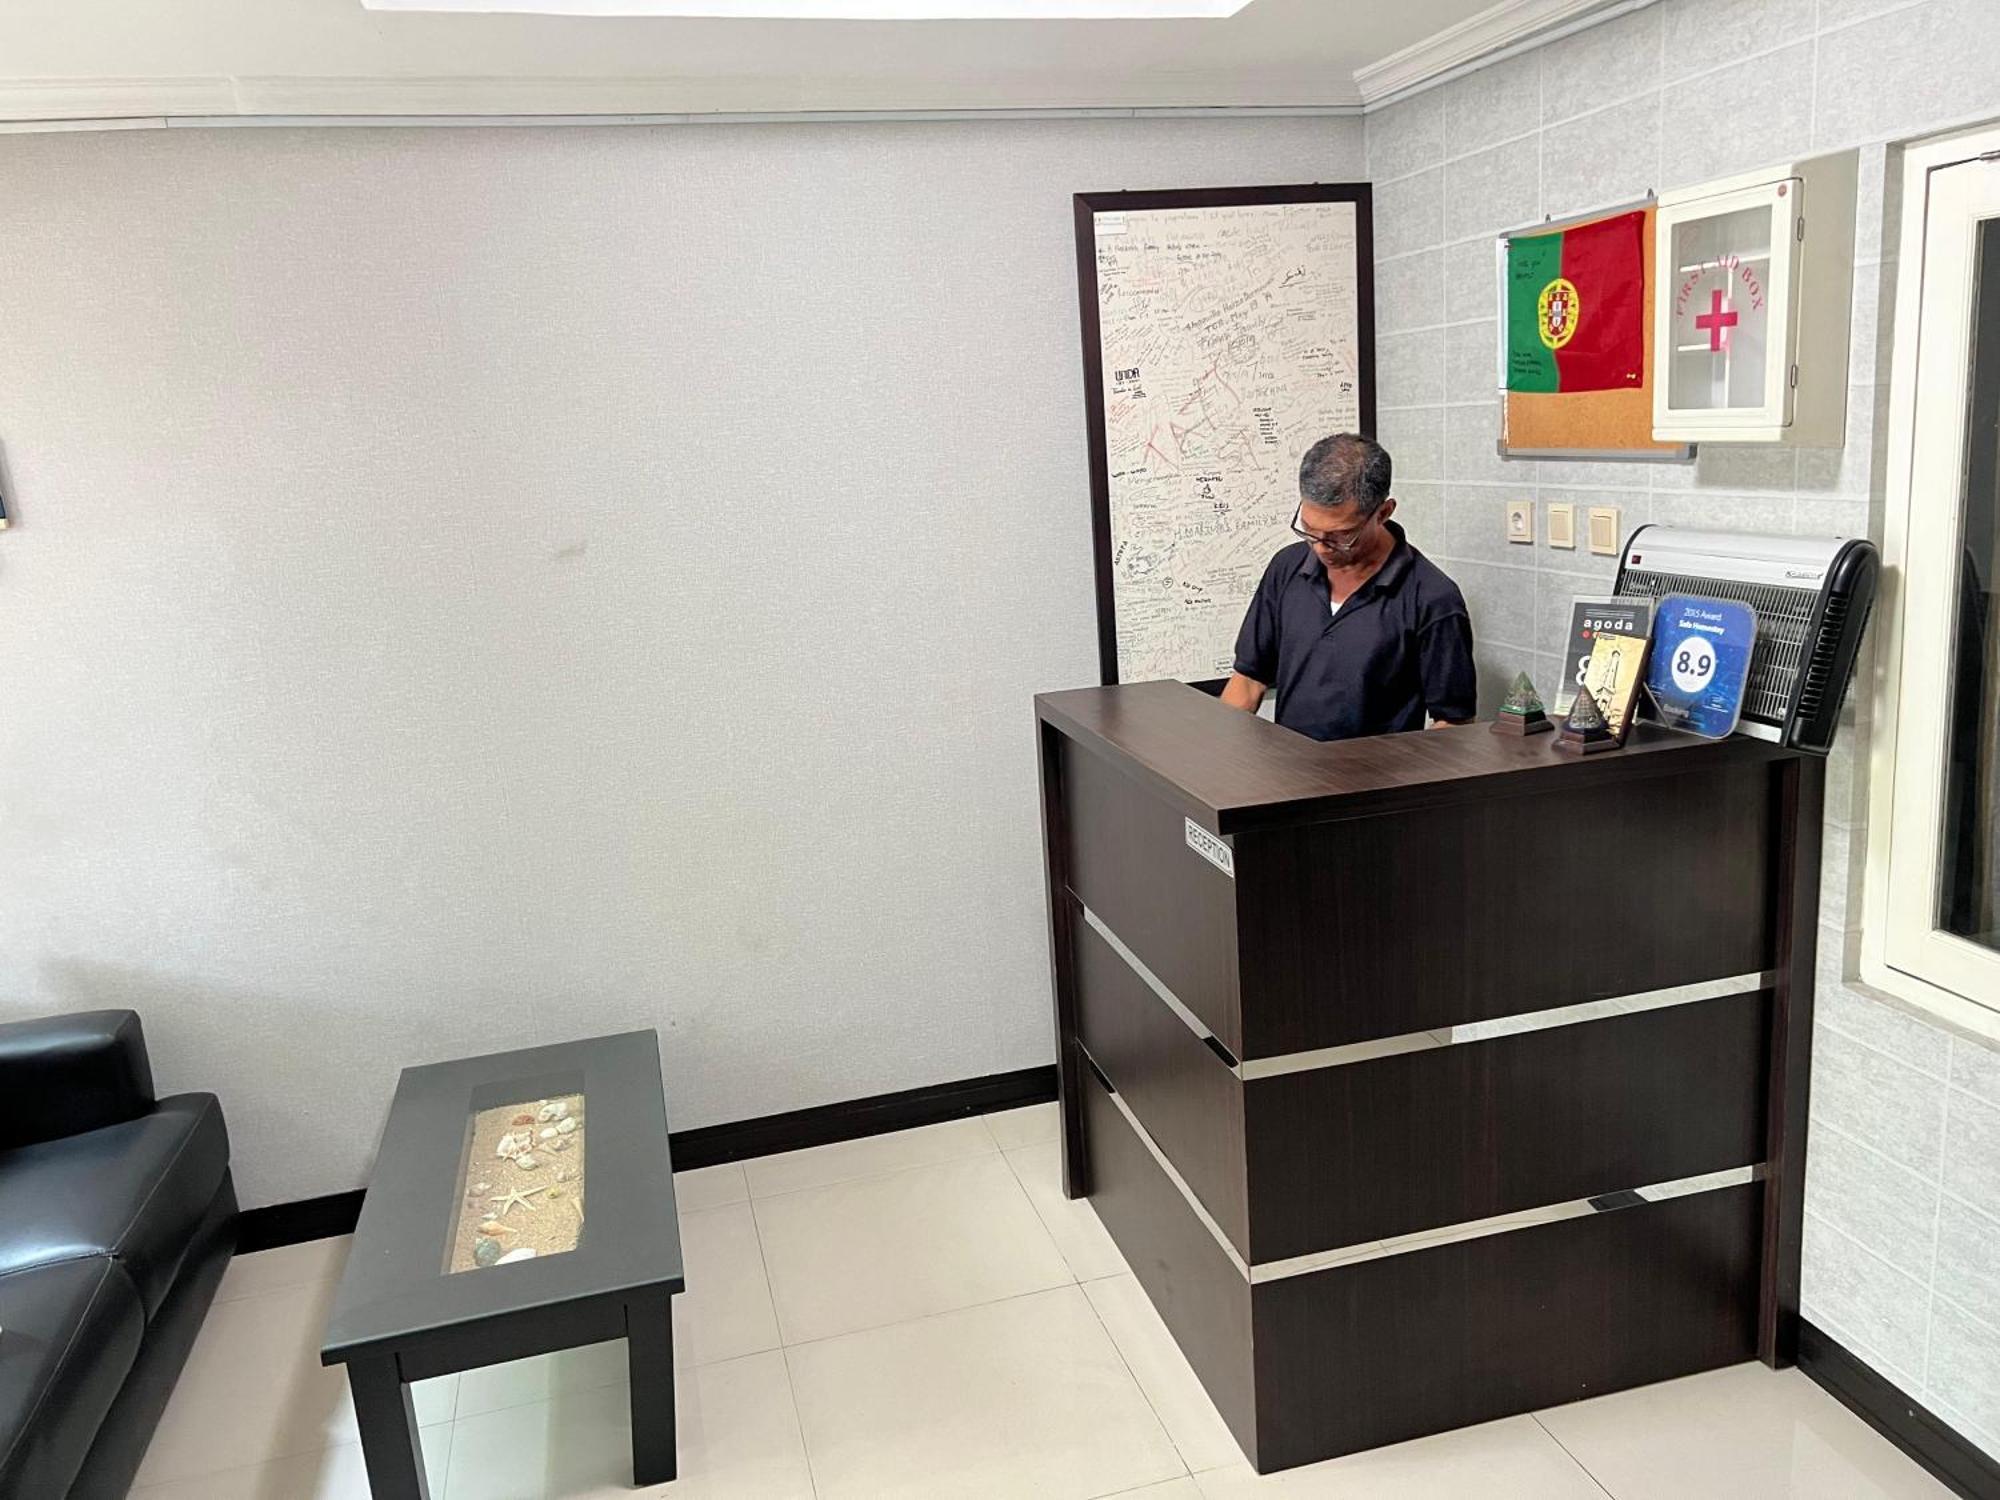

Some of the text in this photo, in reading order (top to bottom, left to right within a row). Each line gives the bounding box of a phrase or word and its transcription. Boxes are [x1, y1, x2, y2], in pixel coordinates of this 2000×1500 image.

[1676, 260, 1706, 318] FIRST
[1742, 266, 1764, 310] BOX
[1583, 619, 1634, 631] agoda
[1701, 611, 1723, 622] Award
[1677, 651, 1712, 677] 8.9
[1187, 824, 1231, 869] RECEPTION
